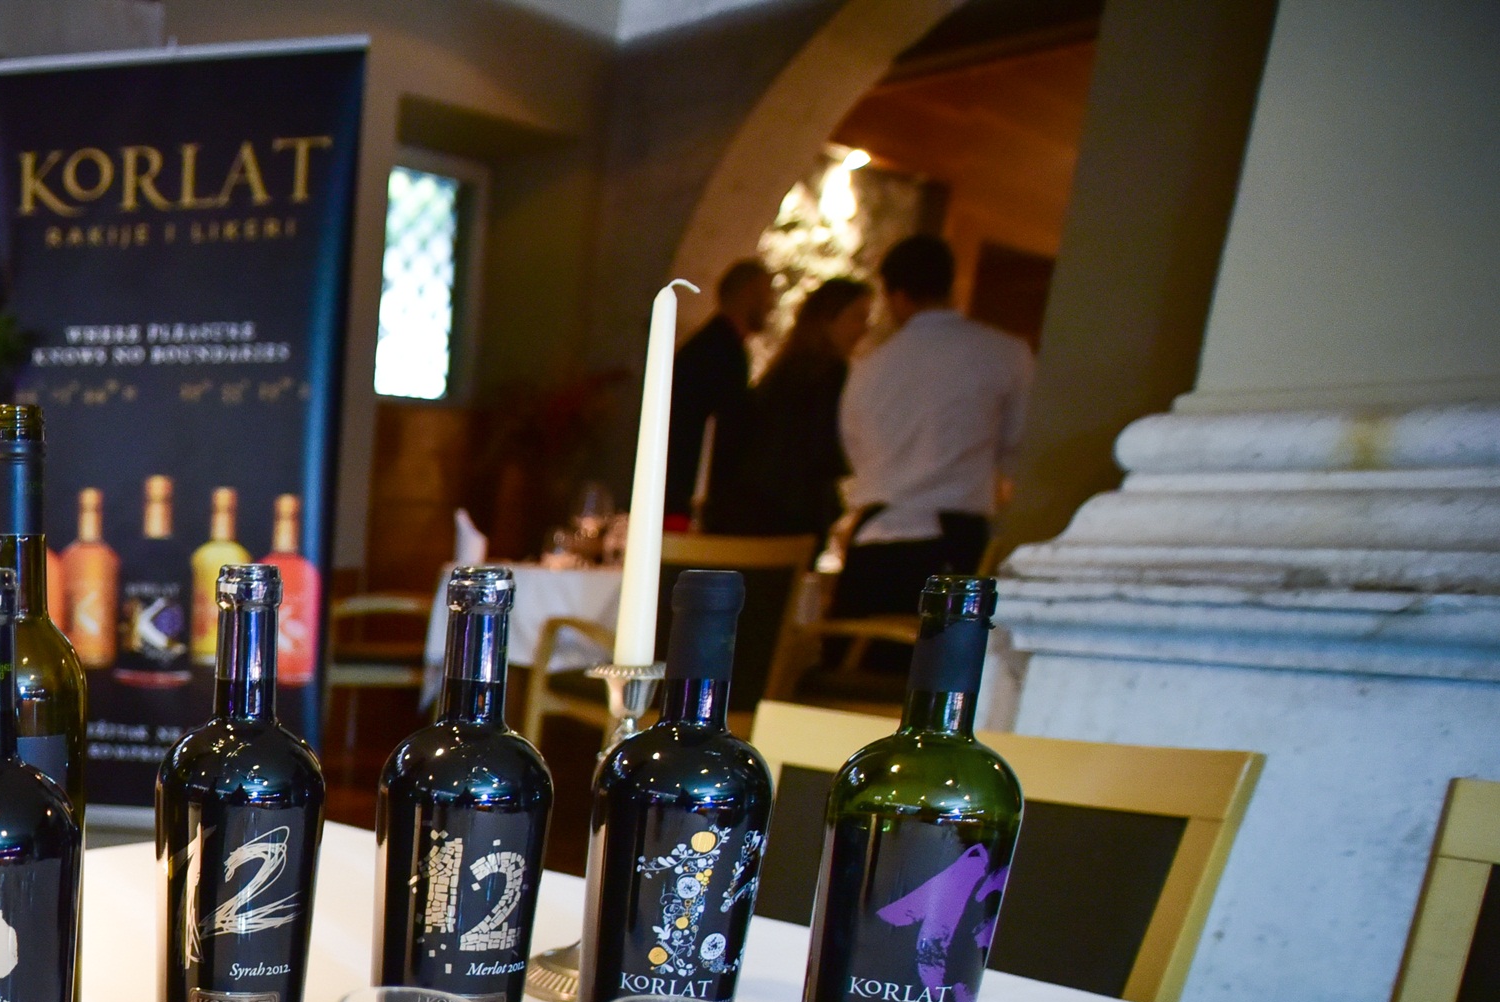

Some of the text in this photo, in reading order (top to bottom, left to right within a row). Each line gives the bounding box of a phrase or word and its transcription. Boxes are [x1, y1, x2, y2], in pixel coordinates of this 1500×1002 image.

[17, 136, 333, 217] KORLAT
[229, 962, 265, 980] Syrah
[465, 961, 507, 976] Merlot
[619, 971, 713, 998] KORLAT
